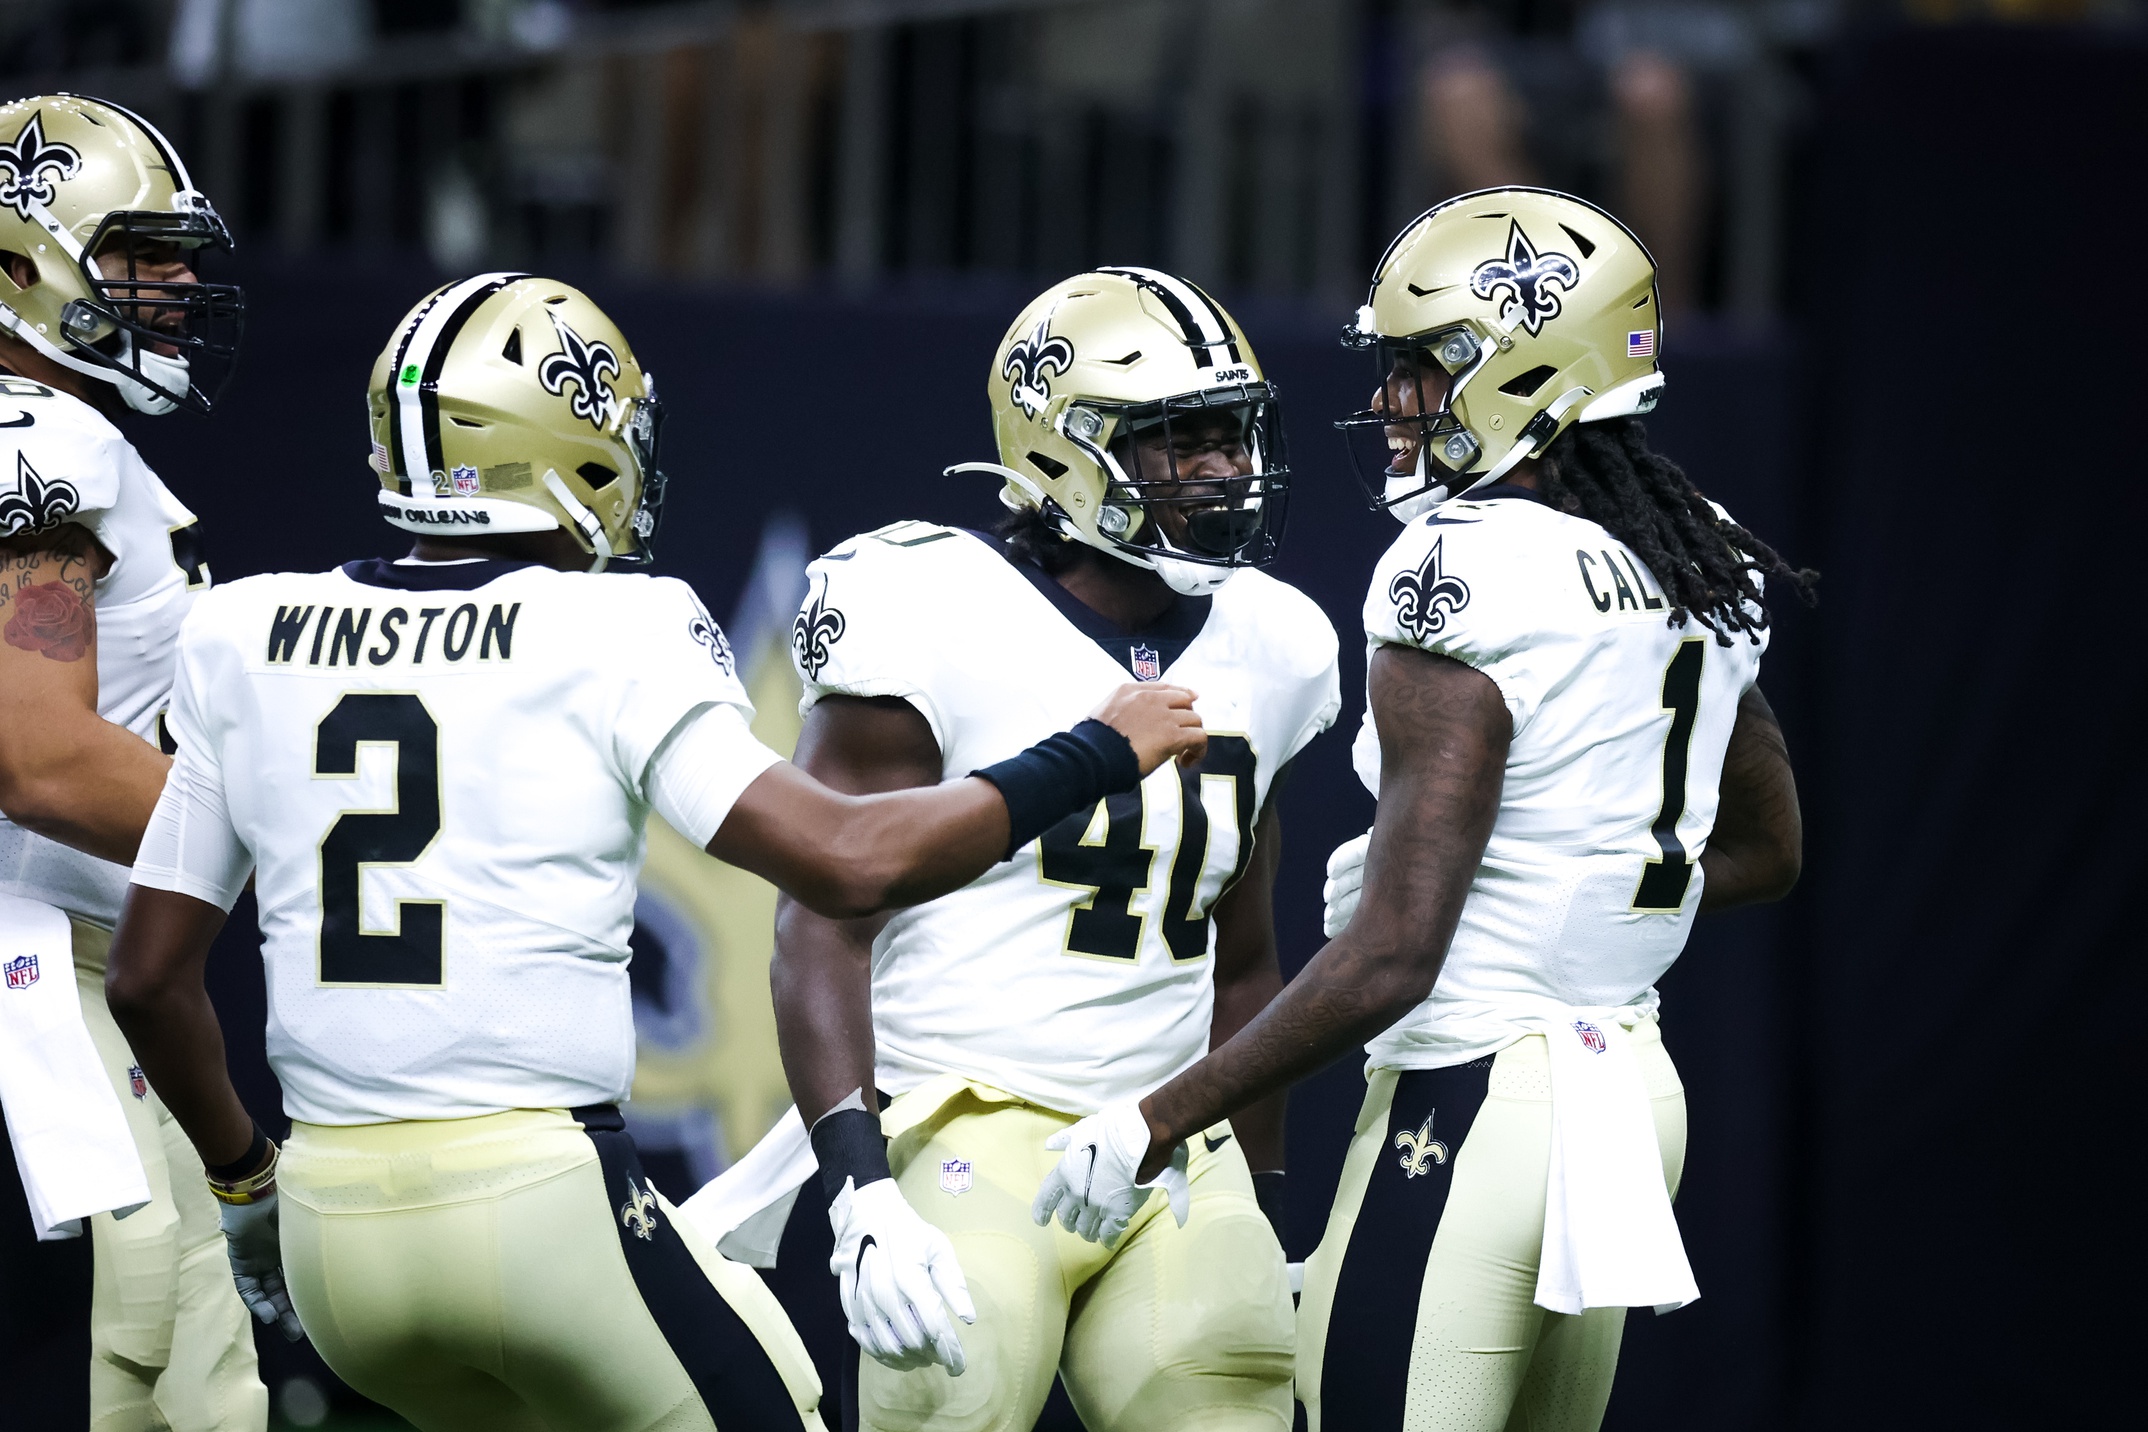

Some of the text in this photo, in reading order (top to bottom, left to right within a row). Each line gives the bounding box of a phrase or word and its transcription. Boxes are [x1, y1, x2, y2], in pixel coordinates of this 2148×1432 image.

[1215, 369, 1249, 382] SAINTS
[430, 469, 451, 496] 2
[456, 479, 478, 492] NFL
[405, 508, 490, 525] ORLEANS
[1575, 548, 1672, 617] CAL
[265, 601, 522, 670] WINSTON
[1137, 661, 1157, 678] NFL
[1629, 635, 1708, 914] 1
[311, 689, 448, 991] 2
[1035, 730, 1258, 967] 40
[8, 966, 38, 987] NFL
[1580, 1031, 1606, 1050] NFL
